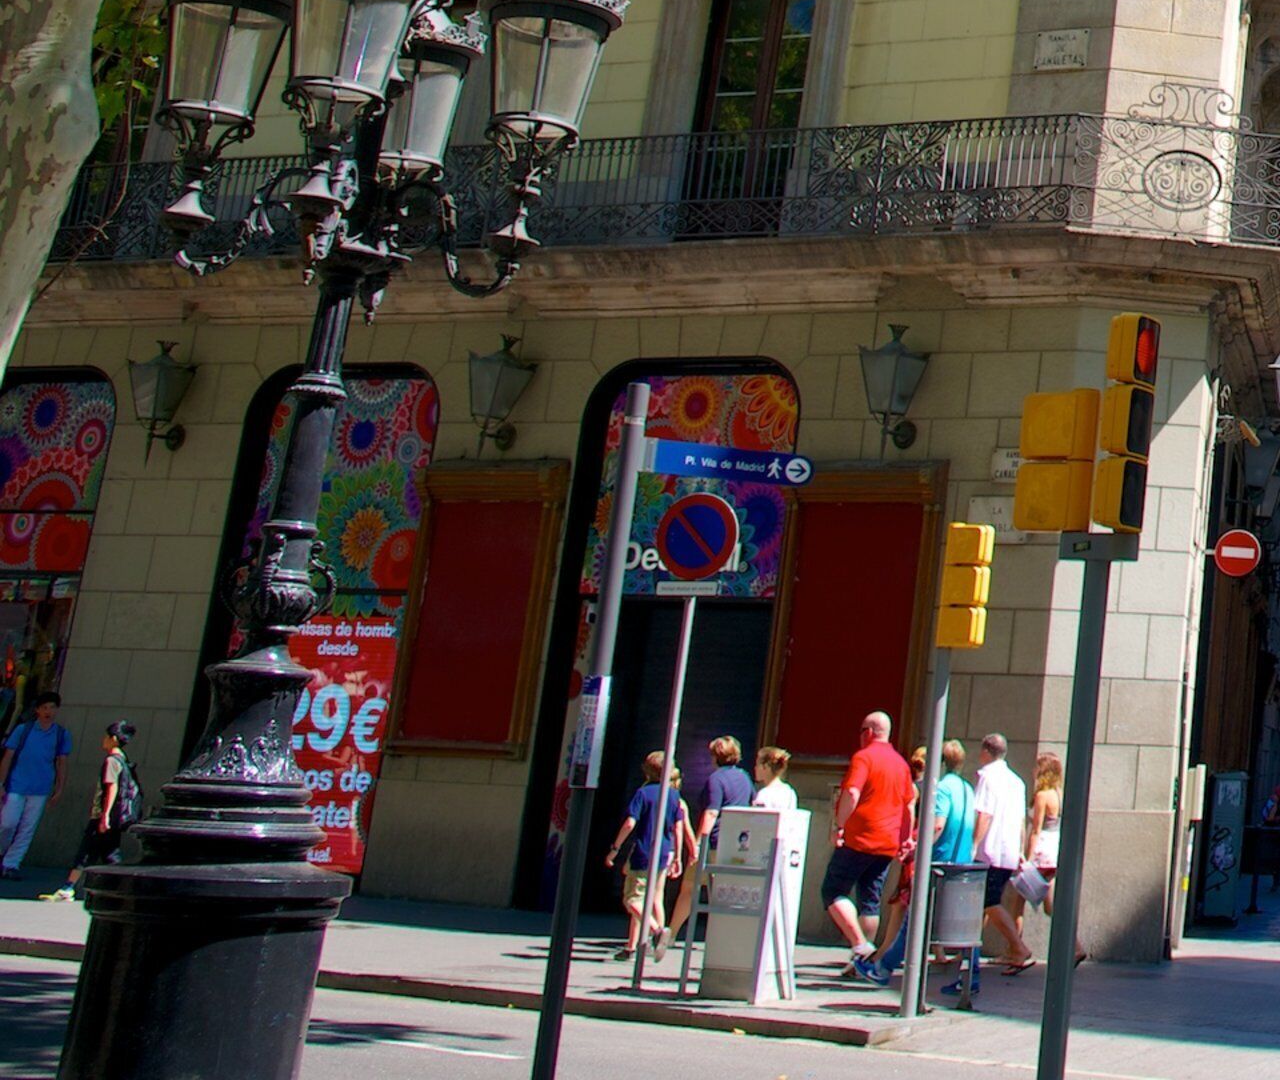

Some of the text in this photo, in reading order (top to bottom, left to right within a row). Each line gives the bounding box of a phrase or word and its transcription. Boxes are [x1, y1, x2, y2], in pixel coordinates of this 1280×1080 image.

[684, 455, 766, 473] Pl. Vila de Madrid
[335, 621, 353, 637] de
[317, 640, 359, 655] desde
[340, 763, 373, 793] de
